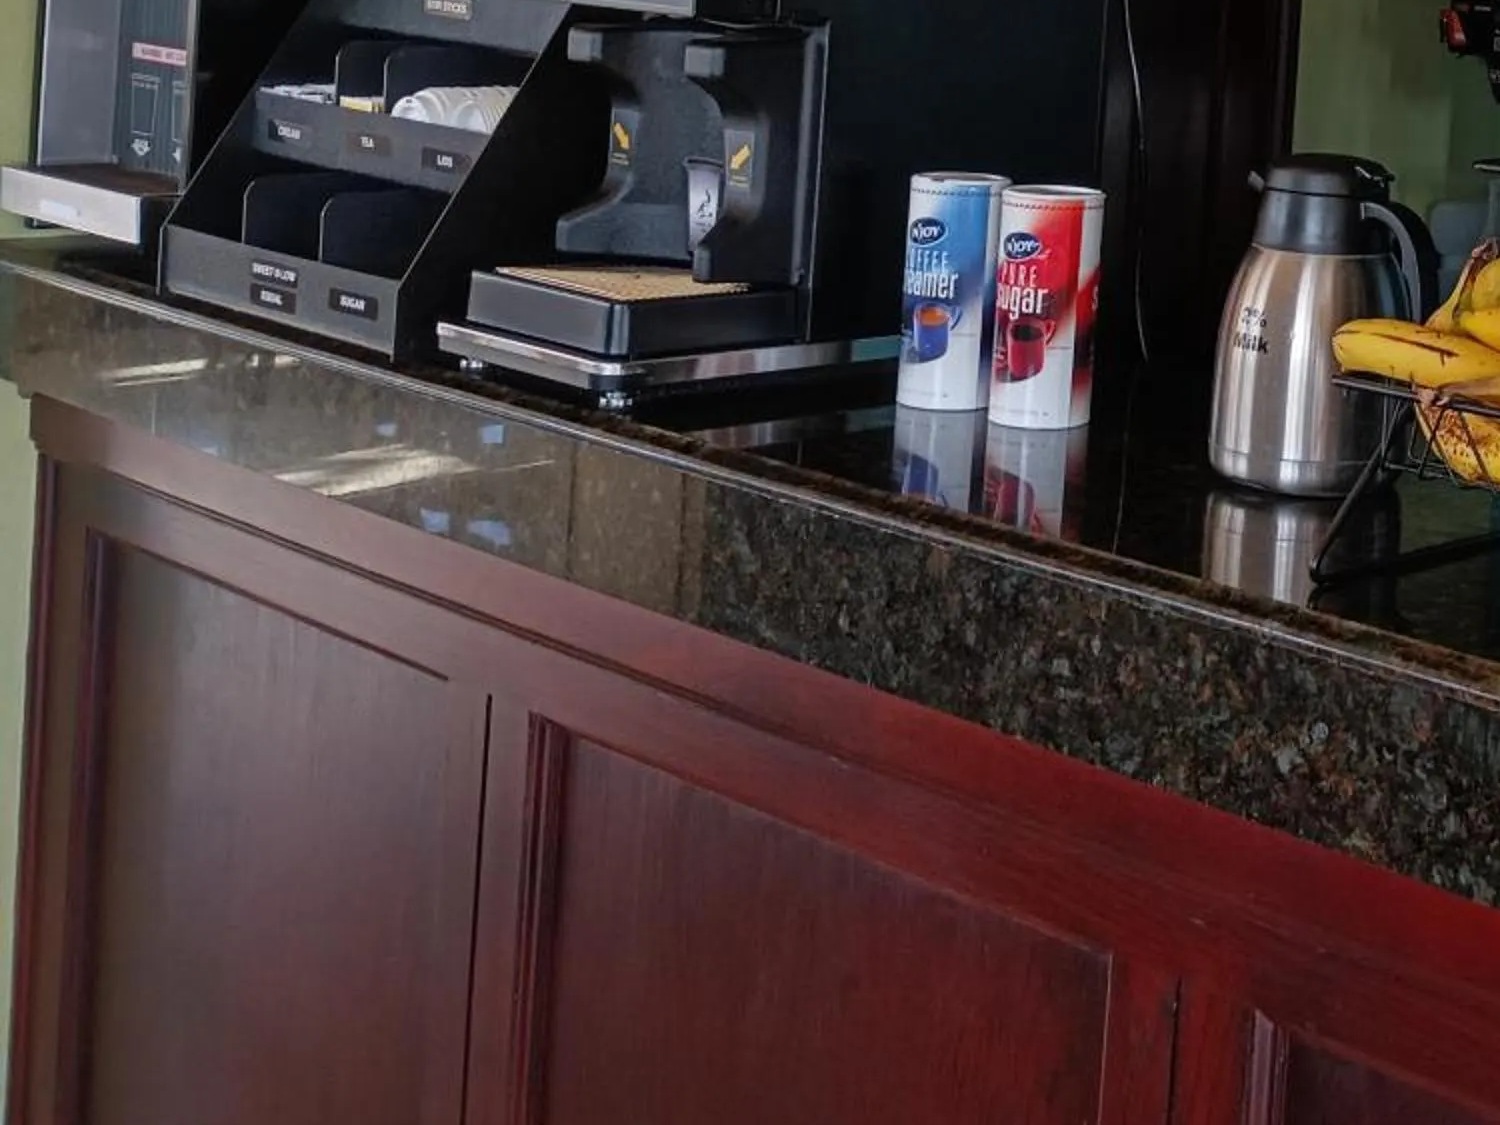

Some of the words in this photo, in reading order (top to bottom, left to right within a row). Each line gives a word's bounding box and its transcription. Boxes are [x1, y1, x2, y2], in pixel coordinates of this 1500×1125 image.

[360, 135, 375, 150] TEA
[338, 294, 367, 312] SUGAR
[1233, 332, 1269, 354] Milk
